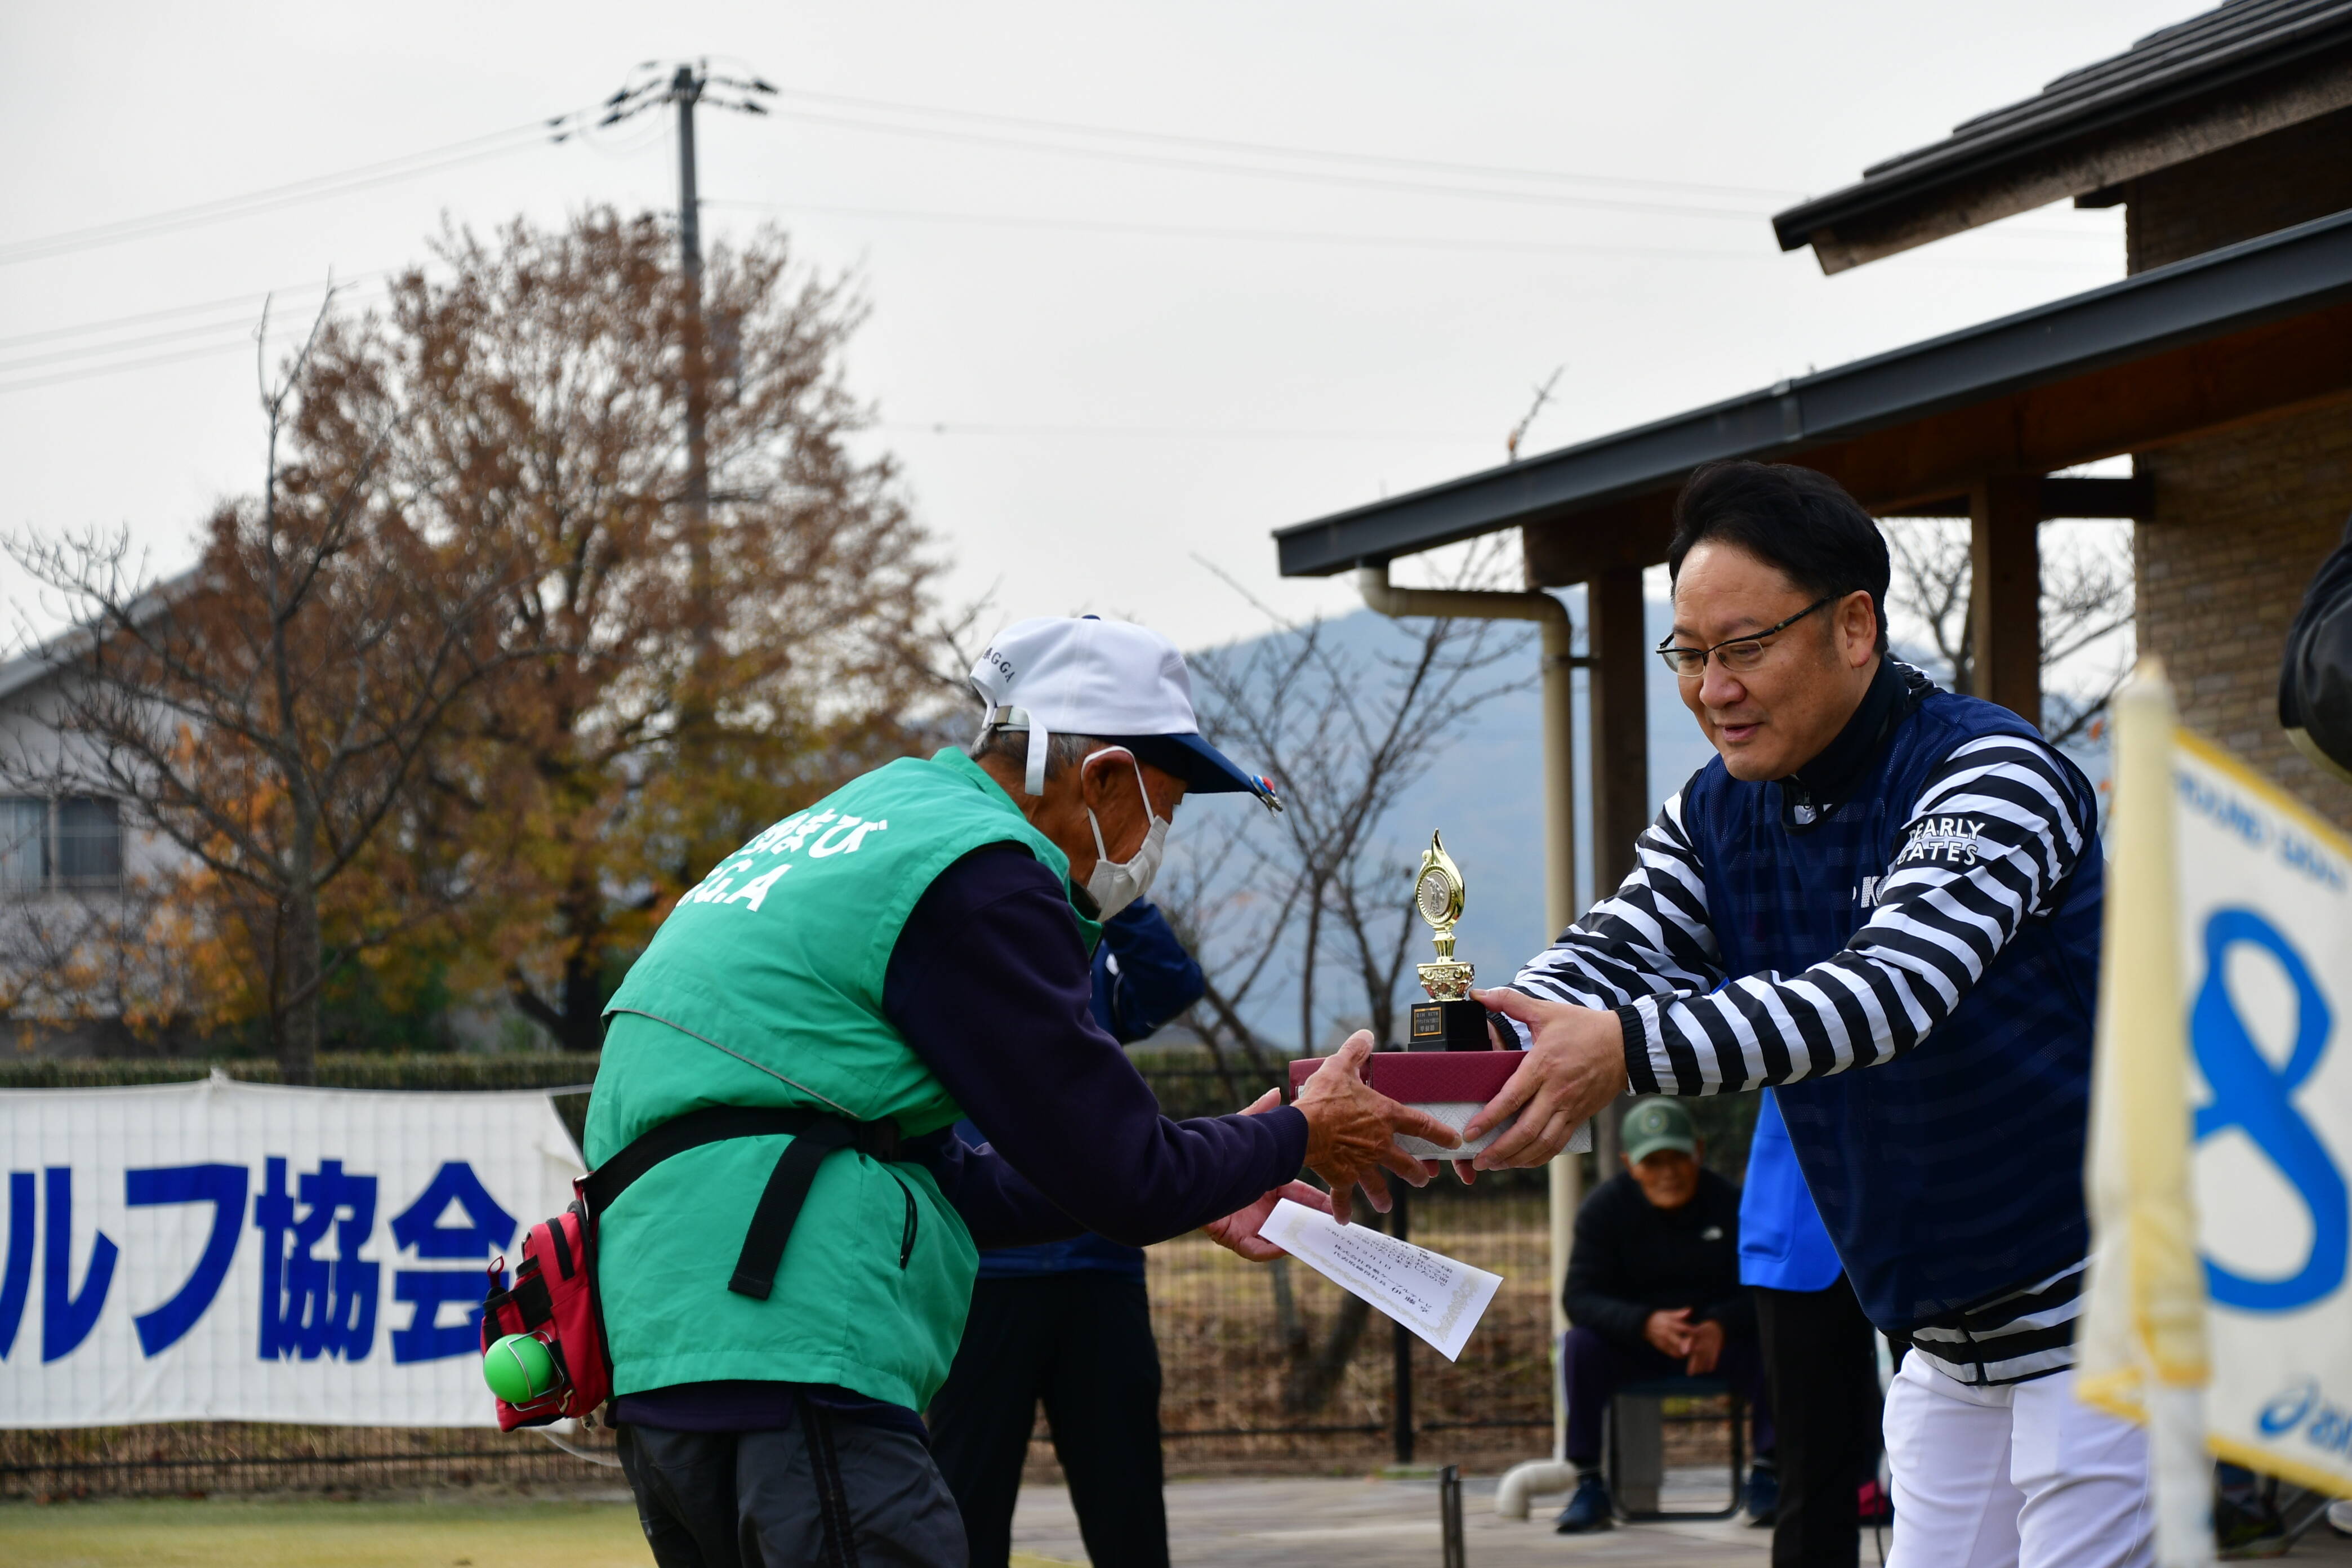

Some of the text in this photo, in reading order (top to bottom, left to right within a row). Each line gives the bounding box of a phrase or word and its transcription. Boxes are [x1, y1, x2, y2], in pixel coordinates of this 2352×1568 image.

[1909, 818, 1985, 841] PEARLY
[1897, 842, 1979, 866] GATES
[2189, 906, 2349, 1311] 8
